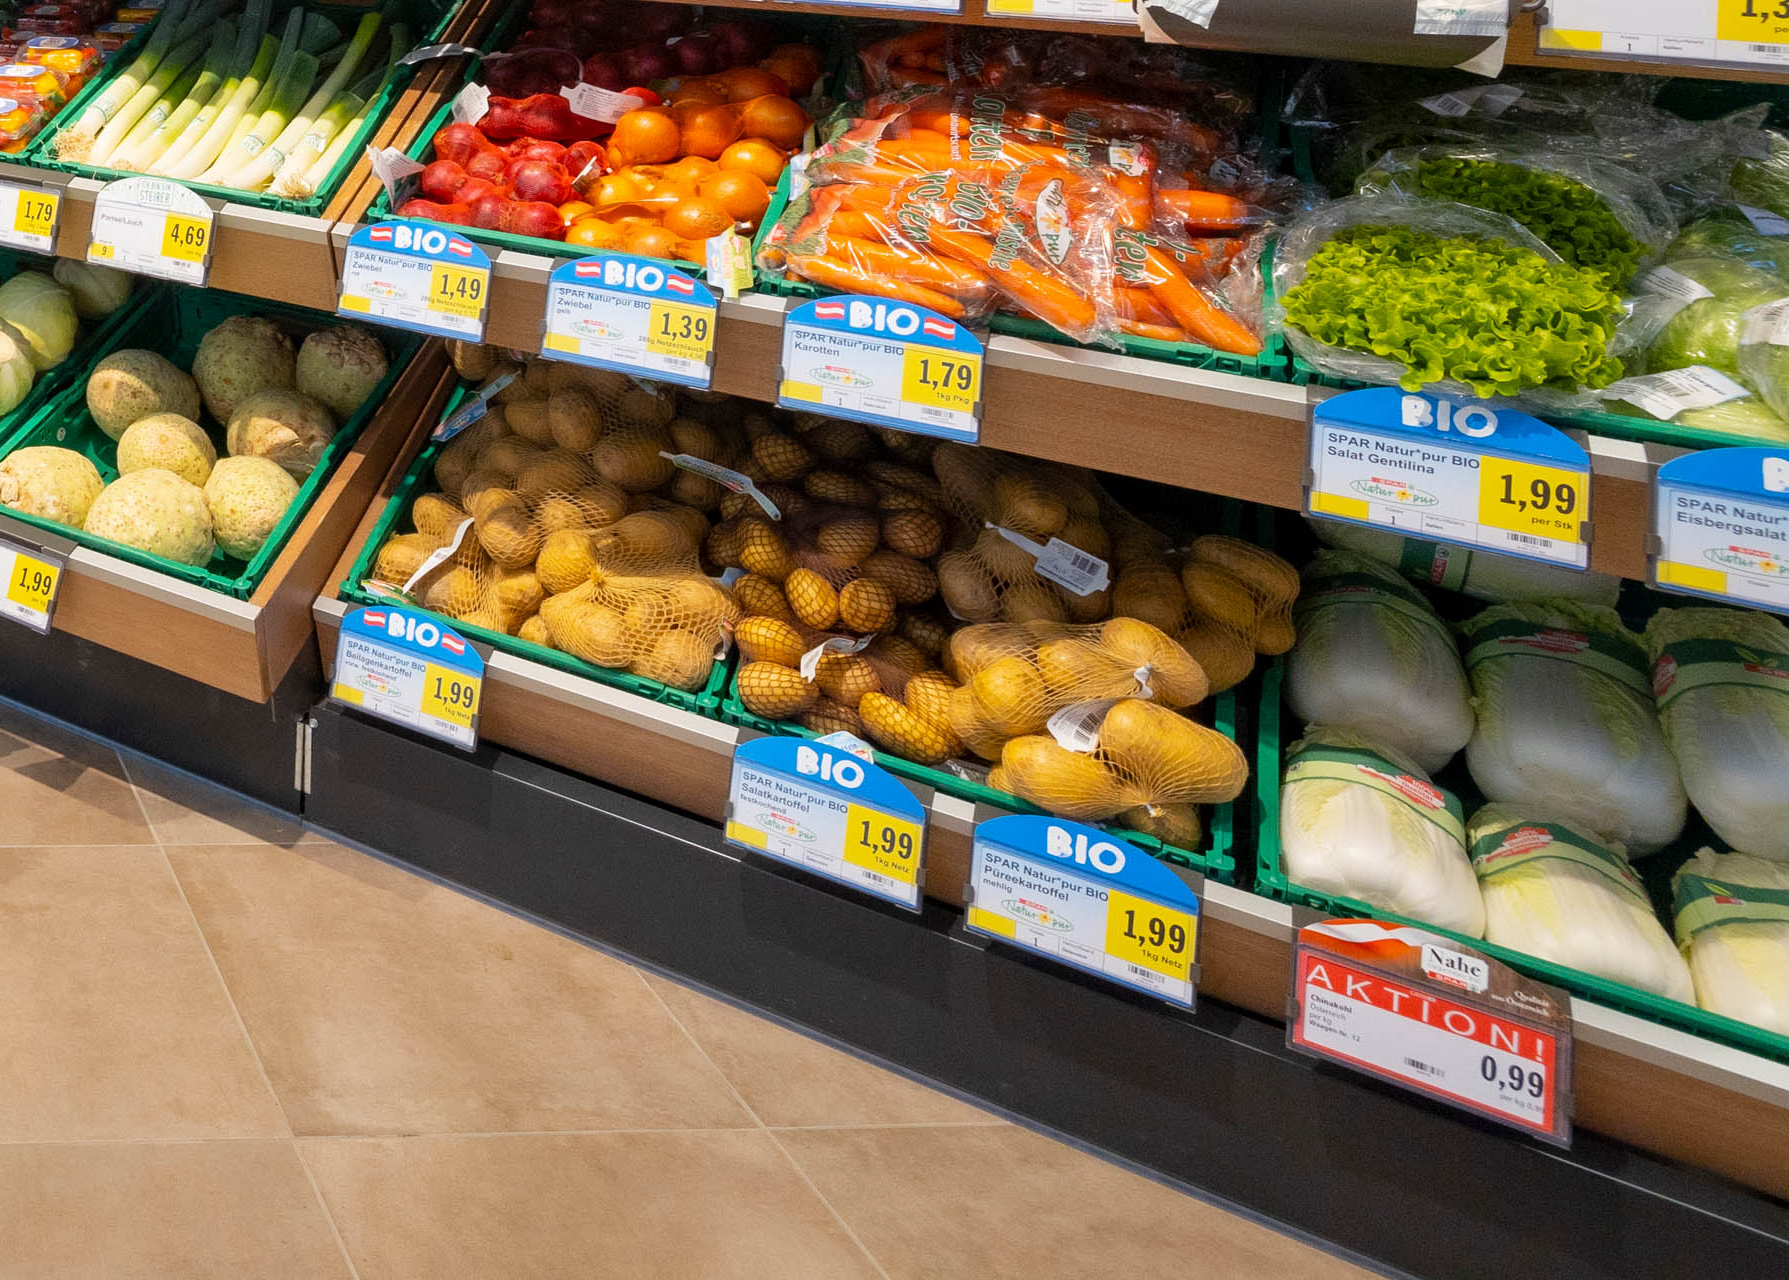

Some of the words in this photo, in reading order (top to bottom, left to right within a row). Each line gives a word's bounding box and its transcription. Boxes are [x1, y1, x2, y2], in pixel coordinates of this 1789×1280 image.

[25, 201, 52, 222] 1,79
[171, 224, 204, 246] 4,69
[394, 225, 447, 254] BIO
[102, 246, 107, 255] 9
[354, 252, 376, 262] SPAR
[418, 262, 432, 272] BIO
[352, 262, 382, 272] Zwiebel
[604, 260, 664, 292] BIO
[440, 274, 481, 300] 1,49
[559, 288, 584, 298] SPAR
[634, 300, 651, 310] BIO
[557, 298, 592, 310] Zwiebel
[849, 301, 920, 336] BIO
[661, 312, 707, 341] 1,39
[795, 330, 826, 343] SPAR
[884, 345, 905, 356] BIO
[795, 342, 840, 357] Karotten
[919, 359, 972, 391] 1,79
[1402, 396, 1498, 438] BIO
[1328, 433, 1370, 448] SPAR
[1452, 456, 1480, 469] BIO
[1328, 446, 1364, 461] Salat
[1368, 454, 1434, 474] Gentilina
[1500, 474, 1575, 515] 1,99
[1677, 497, 1726, 515] SPAR
[1532, 516, 1552, 526] per
[1554, 518, 1572, 530] Stk
[1676, 511, 1787, 542] Eisbergsalat
[20, 568, 52, 596] 1,99
[388, 612, 440, 648] BIO
[346, 650, 412, 678] Beilagenkartoffel
[348, 640, 370, 653] SPAR
[411, 662, 426, 672] BIO
[434, 677, 474, 708] 1,99
[796, 746, 864, 789] BIO
[740, 794, 787, 815] festkochend
[741, 783, 810, 813] Salatkartoffel
[743, 772, 773, 789] SPAR
[828, 801, 848, 814] BIO
[860, 821, 912, 860] 1,99
[1046, 826, 1125, 874] BIO
[891, 862, 909, 873] Netz
[985, 853, 1020, 872] SPAR
[1086, 886, 1109, 902] BIO
[982, 878, 1013, 893] mehlig
[984, 865, 1069, 902] Püreekartoffel
[1124, 910, 1185, 954] 1,99
[1142, 948, 1159, 962] 1kg
[1162, 956, 1183, 969] Netz
[1428, 947, 1482, 978] Nahe
[1435, 974, 1468, 990] SPAR
[1306, 964, 1544, 1063] AKTION!
[1311, 994, 1352, 1013] Chinakohl
[1481, 1055, 1544, 1098] 0,99
